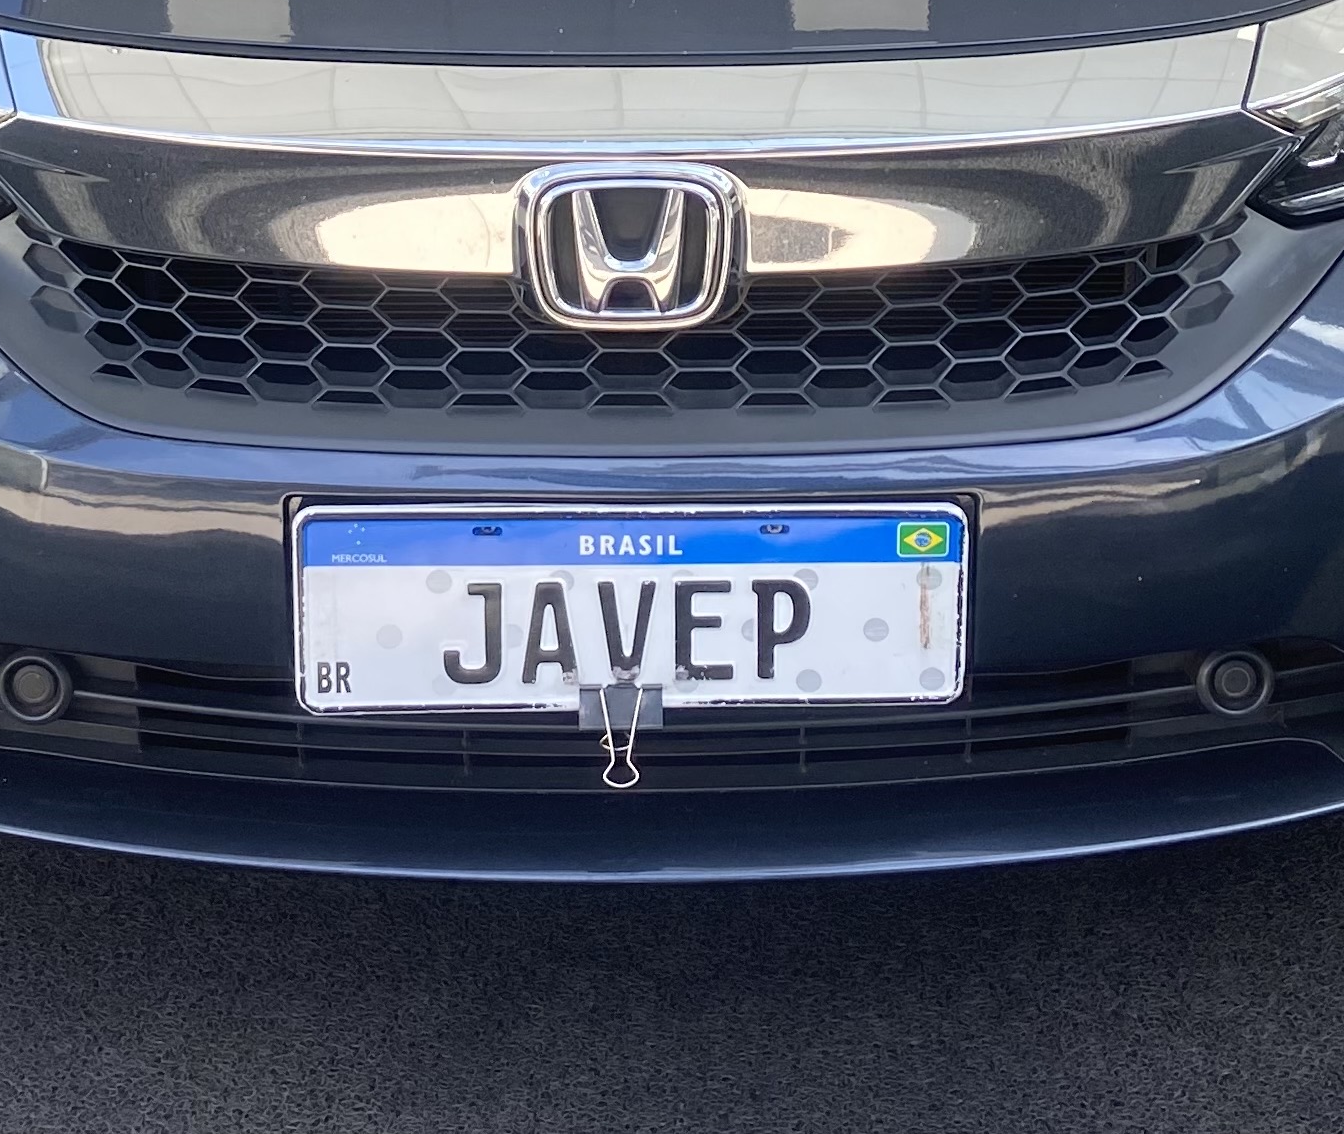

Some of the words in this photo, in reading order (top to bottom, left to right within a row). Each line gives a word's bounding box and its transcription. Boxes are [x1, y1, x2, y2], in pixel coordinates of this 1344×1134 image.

[331, 554, 387, 563] MERCOSUL
[578, 534, 683, 556] BRASIL
[443, 580, 810, 684] JAVEP
[317, 662, 351, 694] BR
